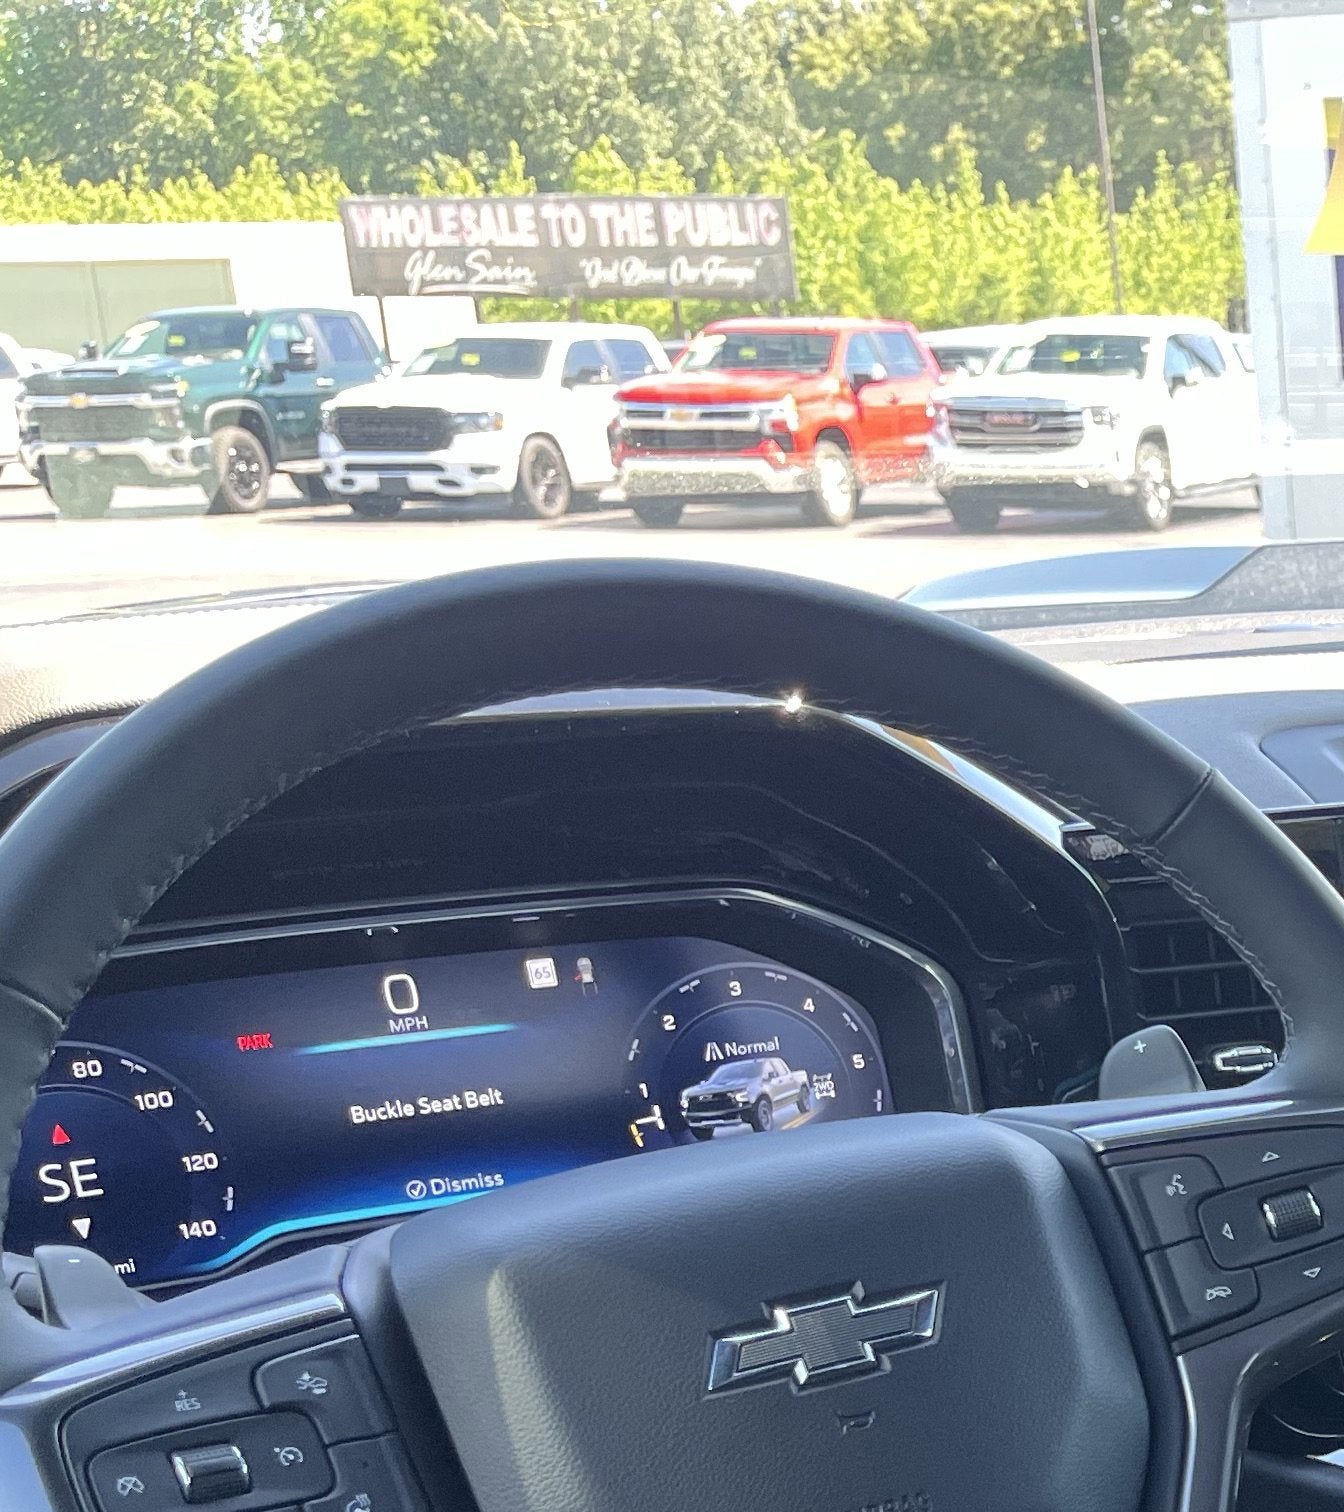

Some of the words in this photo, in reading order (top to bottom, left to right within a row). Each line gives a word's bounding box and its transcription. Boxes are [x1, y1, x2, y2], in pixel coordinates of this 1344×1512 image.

[348, 202, 540, 249] WHOLESALE
[541, 203, 588, 249] TO
[589, 202, 657, 248] THE
[661, 202, 783, 249] PUBLIC
[404, 248, 464, 295] Glen
[465, 248, 538, 288] Sain
[533, 965, 551, 980] 65
[383, 972, 419, 1015] 0
[729, 980, 743, 996] 3
[803, 998, 815, 1013] 4
[389, 1015, 429, 1034] MPH
[662, 1014, 676, 1031] 2
[236, 1032, 272, 1051] PARK
[725, 1035, 780, 1058] Normal
[72, 1059, 102, 1079] 80
[853, 1053, 865, 1069] 5
[639, 1082, 648, 1099] 1
[134, 1090, 174, 1111] 100
[350, 1099, 415, 1125] Buckle
[418, 1094, 463, 1116] Seat
[465, 1088, 504, 1110] Belt
[182, 1152, 219, 1171] 120
[38, 1157, 105, 1203] SE
[430, 1171, 505, 1196] Dismiss
[179, 1219, 217, 1240] 140
[175, 1397, 201, 1412] RES
